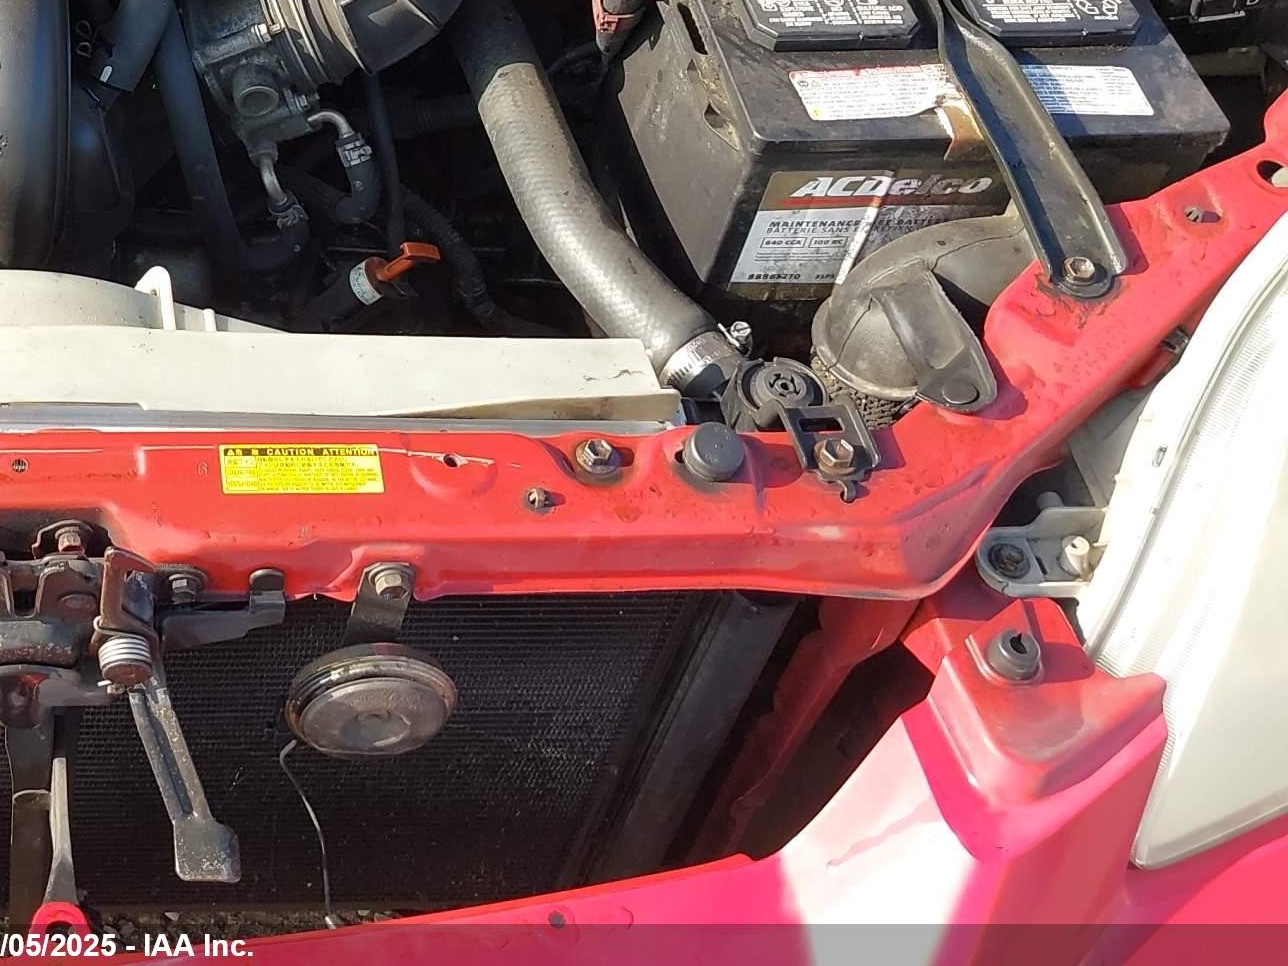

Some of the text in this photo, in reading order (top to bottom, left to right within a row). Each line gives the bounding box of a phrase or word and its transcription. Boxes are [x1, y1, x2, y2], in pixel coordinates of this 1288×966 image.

[789, 175, 993, 198] ACDelco
[769, 219, 862, 228] MAINTENANCE
[822, 226, 849, 234] SANS
[322, 448, 377, 456] ATTENTION
